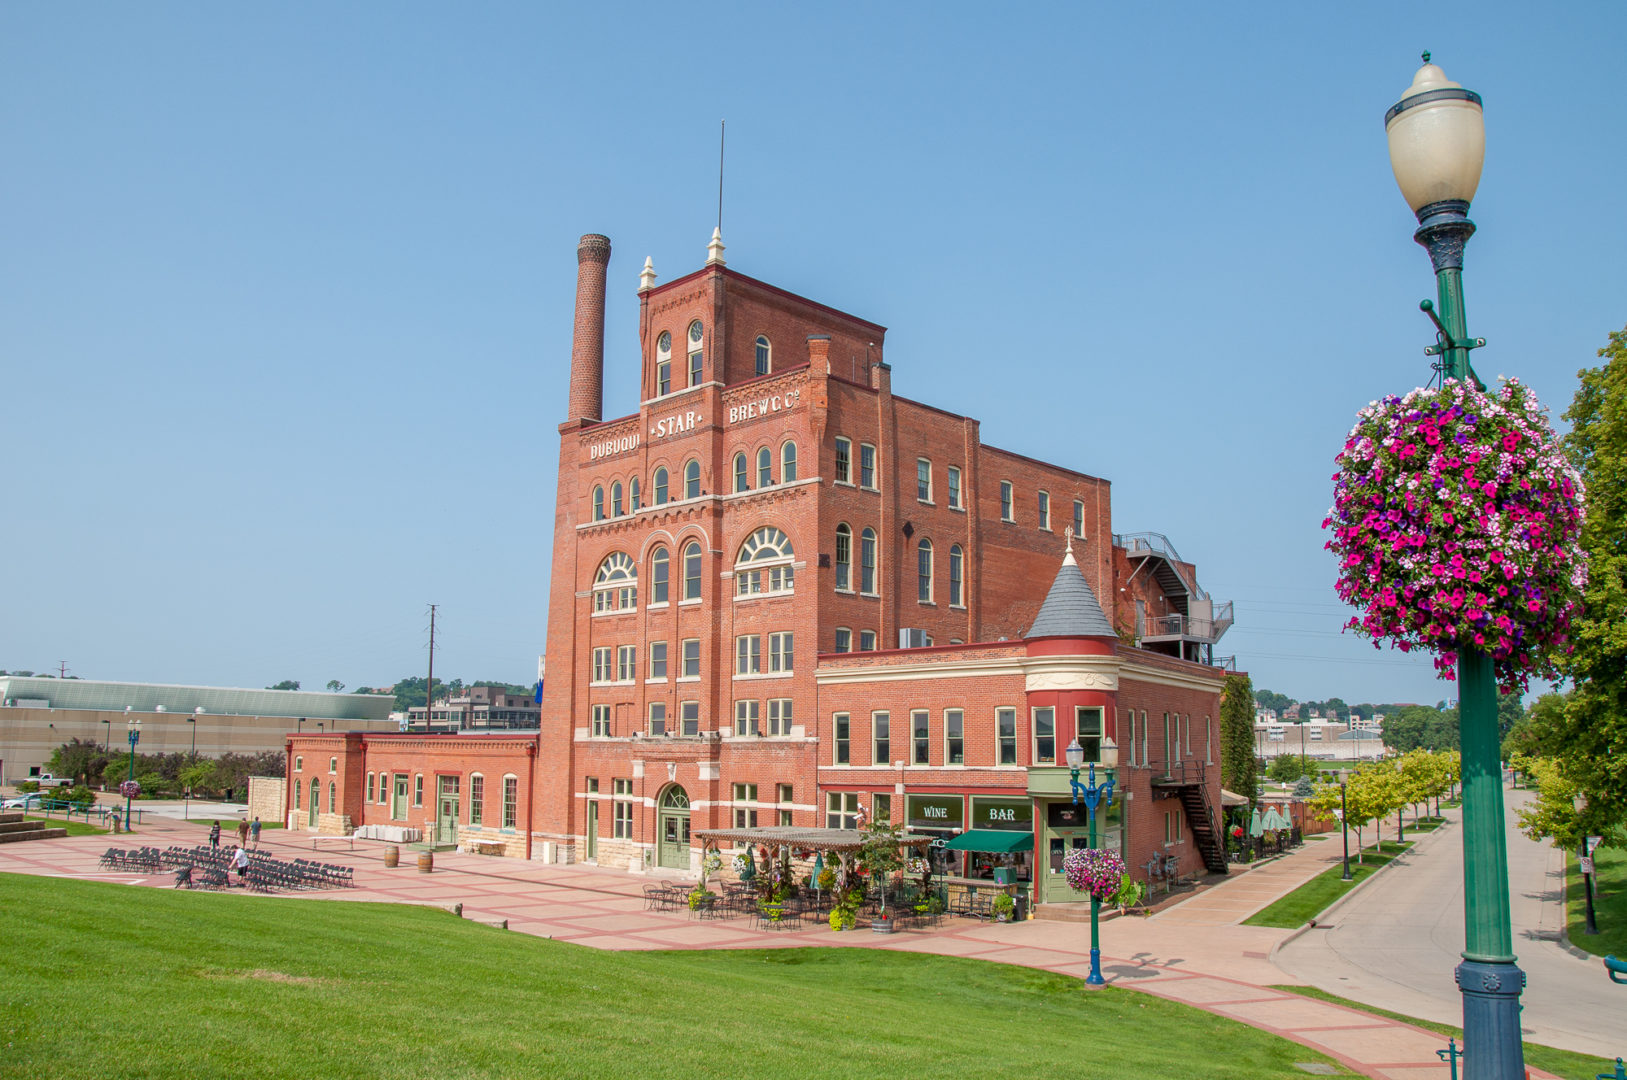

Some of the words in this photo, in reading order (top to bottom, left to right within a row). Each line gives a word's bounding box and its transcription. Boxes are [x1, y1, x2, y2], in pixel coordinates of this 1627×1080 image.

[657, 411, 695, 438] STAR
[923, 806, 948, 818] WINE
[989, 808, 1016, 821] BAR
